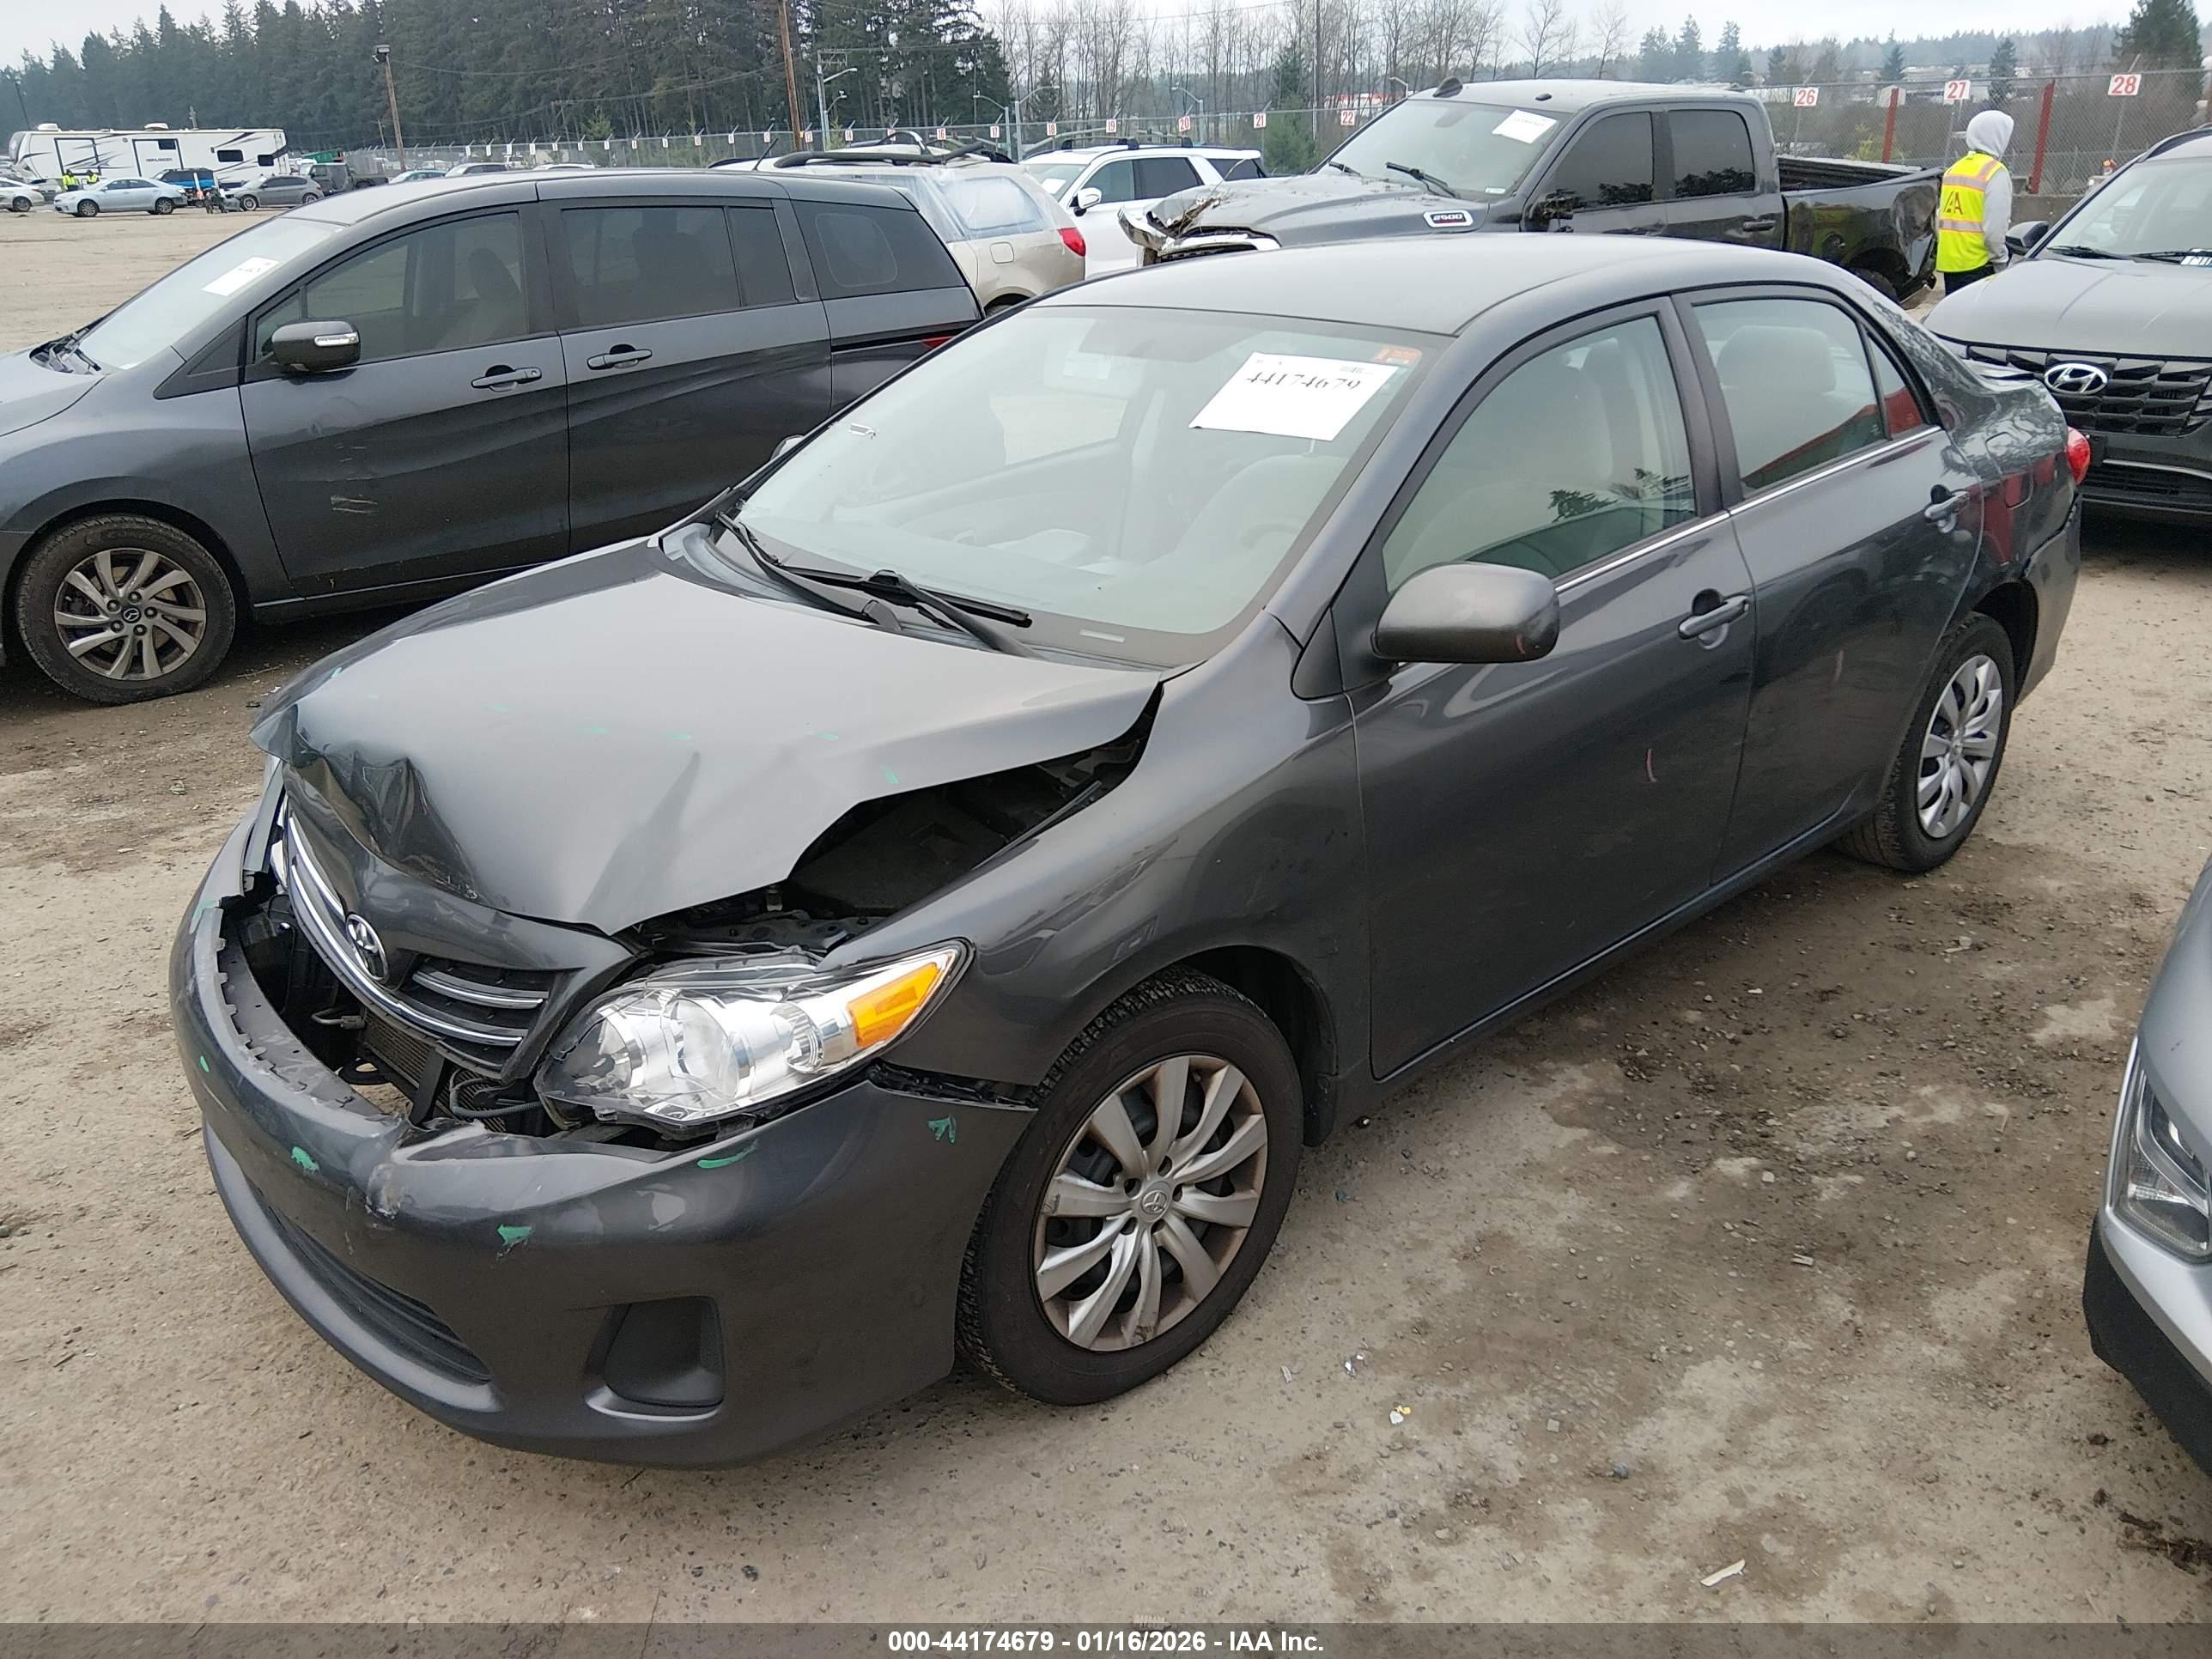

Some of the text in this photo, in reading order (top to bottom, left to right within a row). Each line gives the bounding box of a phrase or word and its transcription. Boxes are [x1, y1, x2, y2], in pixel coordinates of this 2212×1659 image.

[1947, 82, 1966, 99] 27
[2112, 76, 2137, 94] 28
[1796, 89, 1815, 104] 26
[1181, 117, 1188, 130] 20
[1256, 114, 1264, 126] 21
[1343, 112, 1353, 124] 22
[1048, 123, 1055, 135] 18
[1109, 120, 1115, 131] 19
[939, 128, 945, 138] 16
[1247, 372, 1361, 389] 44174679
